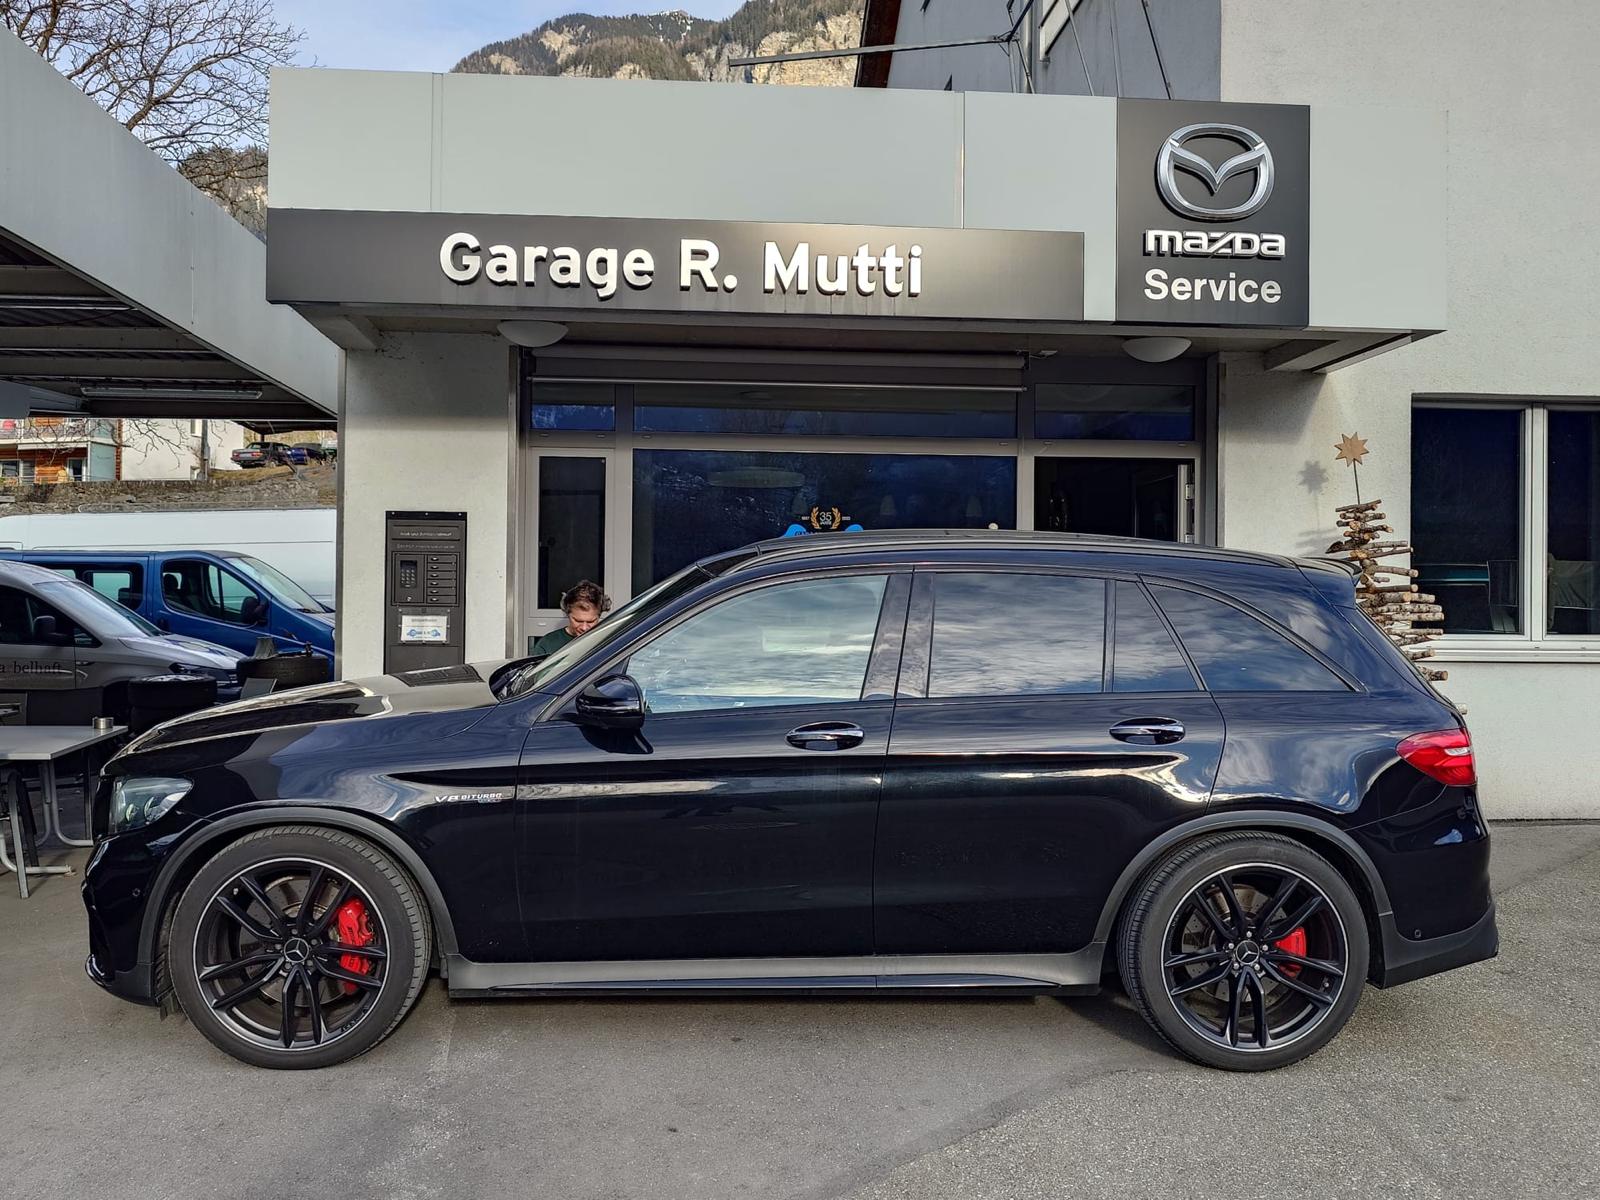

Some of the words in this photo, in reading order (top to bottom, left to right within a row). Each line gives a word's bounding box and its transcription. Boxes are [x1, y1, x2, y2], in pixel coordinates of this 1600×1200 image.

[1144, 229, 1286, 257] mazda
[439, 232, 655, 299] Garage
[679, 238, 738, 292] R.
[763, 241, 923, 297] Mutti
[1144, 268, 1282, 303] Service
[819, 511, 832, 522] 35
[435, 795, 459, 803] V8
